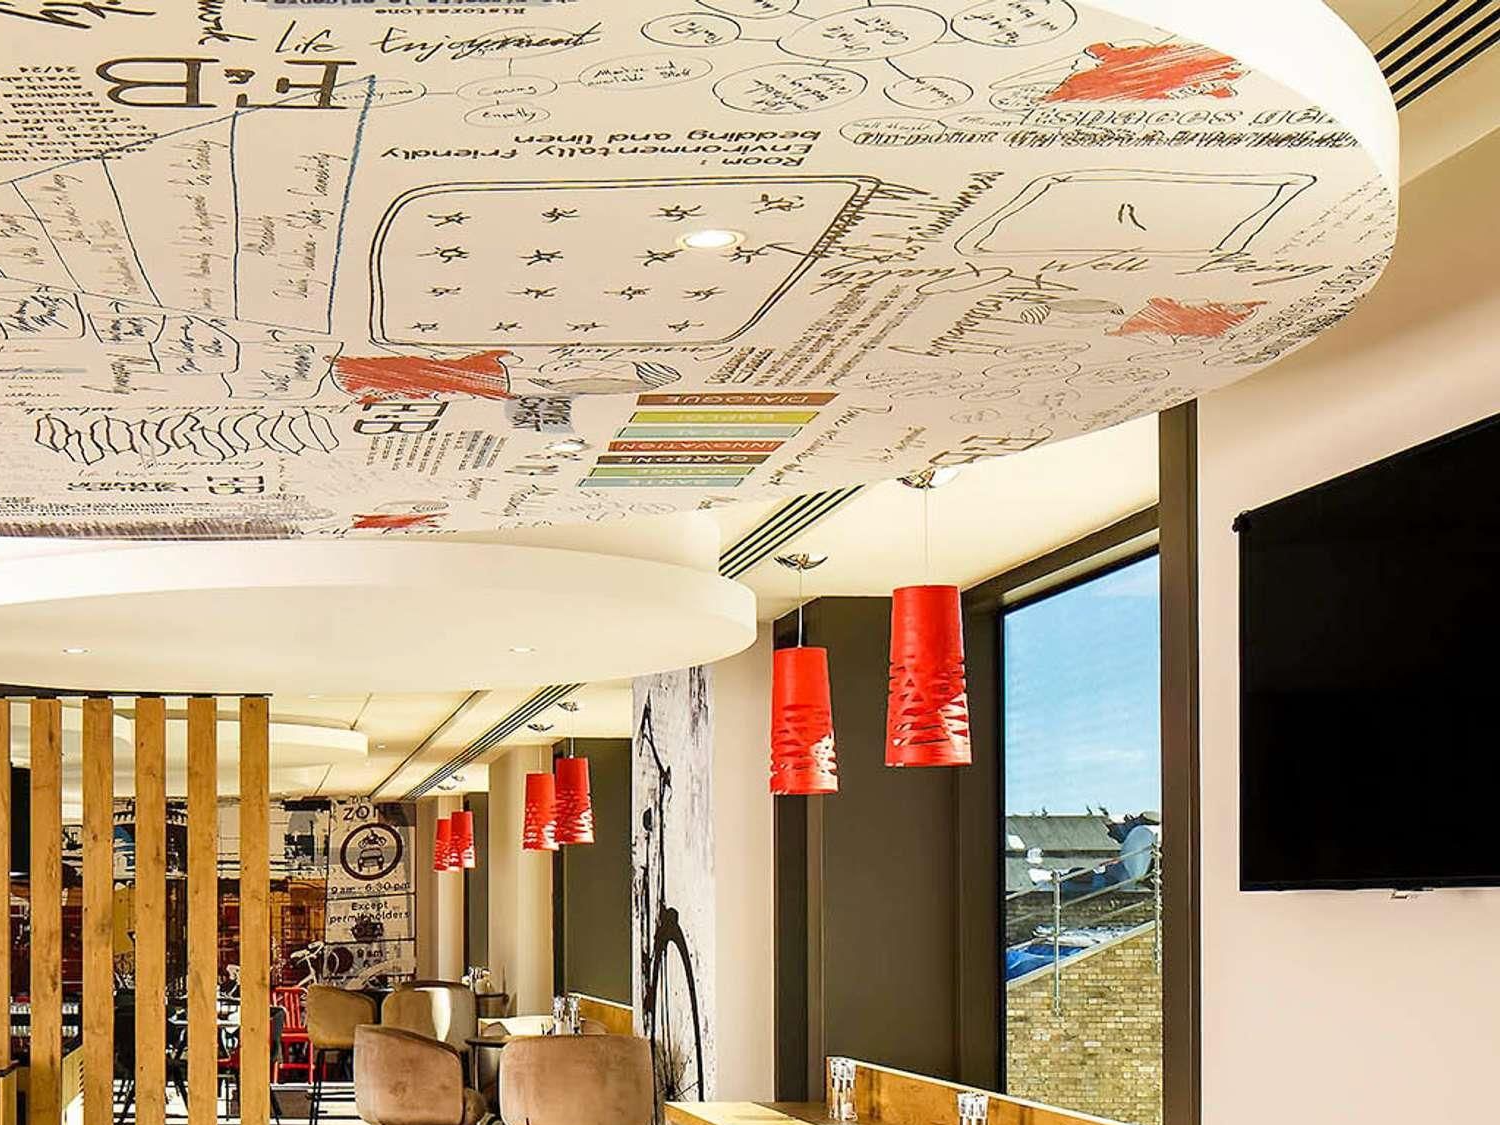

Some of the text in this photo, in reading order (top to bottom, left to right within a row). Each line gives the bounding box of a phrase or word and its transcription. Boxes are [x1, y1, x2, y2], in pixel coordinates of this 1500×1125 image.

[275, 20, 343, 52] Life
[513, 129, 821, 144] bedding and linen
[380, 146, 517, 159] friendly
[812, 259, 1013, 295] Quality
[667, 395, 808, 403] DIALOGUE
[619, 441, 775, 449] INNOVATION
[617, 454, 747, 462] CARBONE
[351, 901, 389, 913] Except
